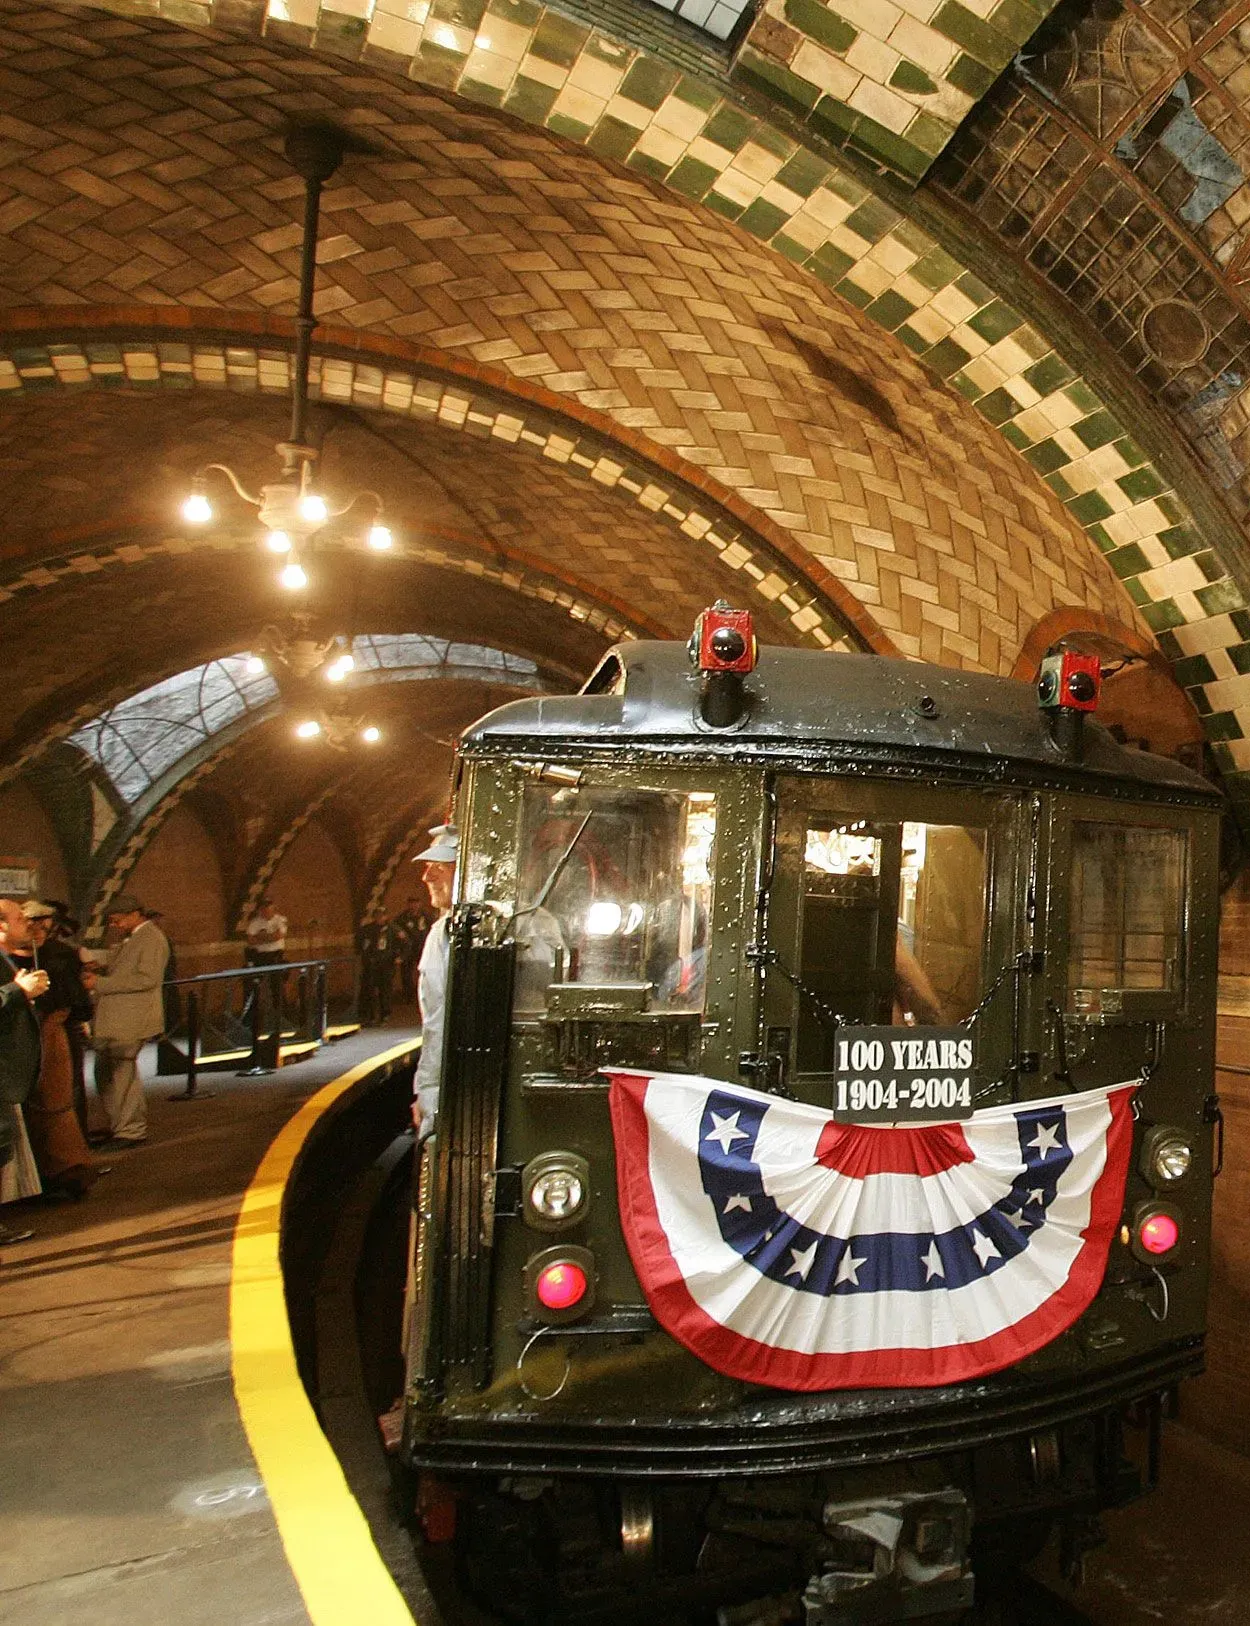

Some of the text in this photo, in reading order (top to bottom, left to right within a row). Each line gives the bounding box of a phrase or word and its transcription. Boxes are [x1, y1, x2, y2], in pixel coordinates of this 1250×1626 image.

[838, 1040, 973, 1071] 100 YEARS
[837, 1078, 971, 1111] 1904-2004
